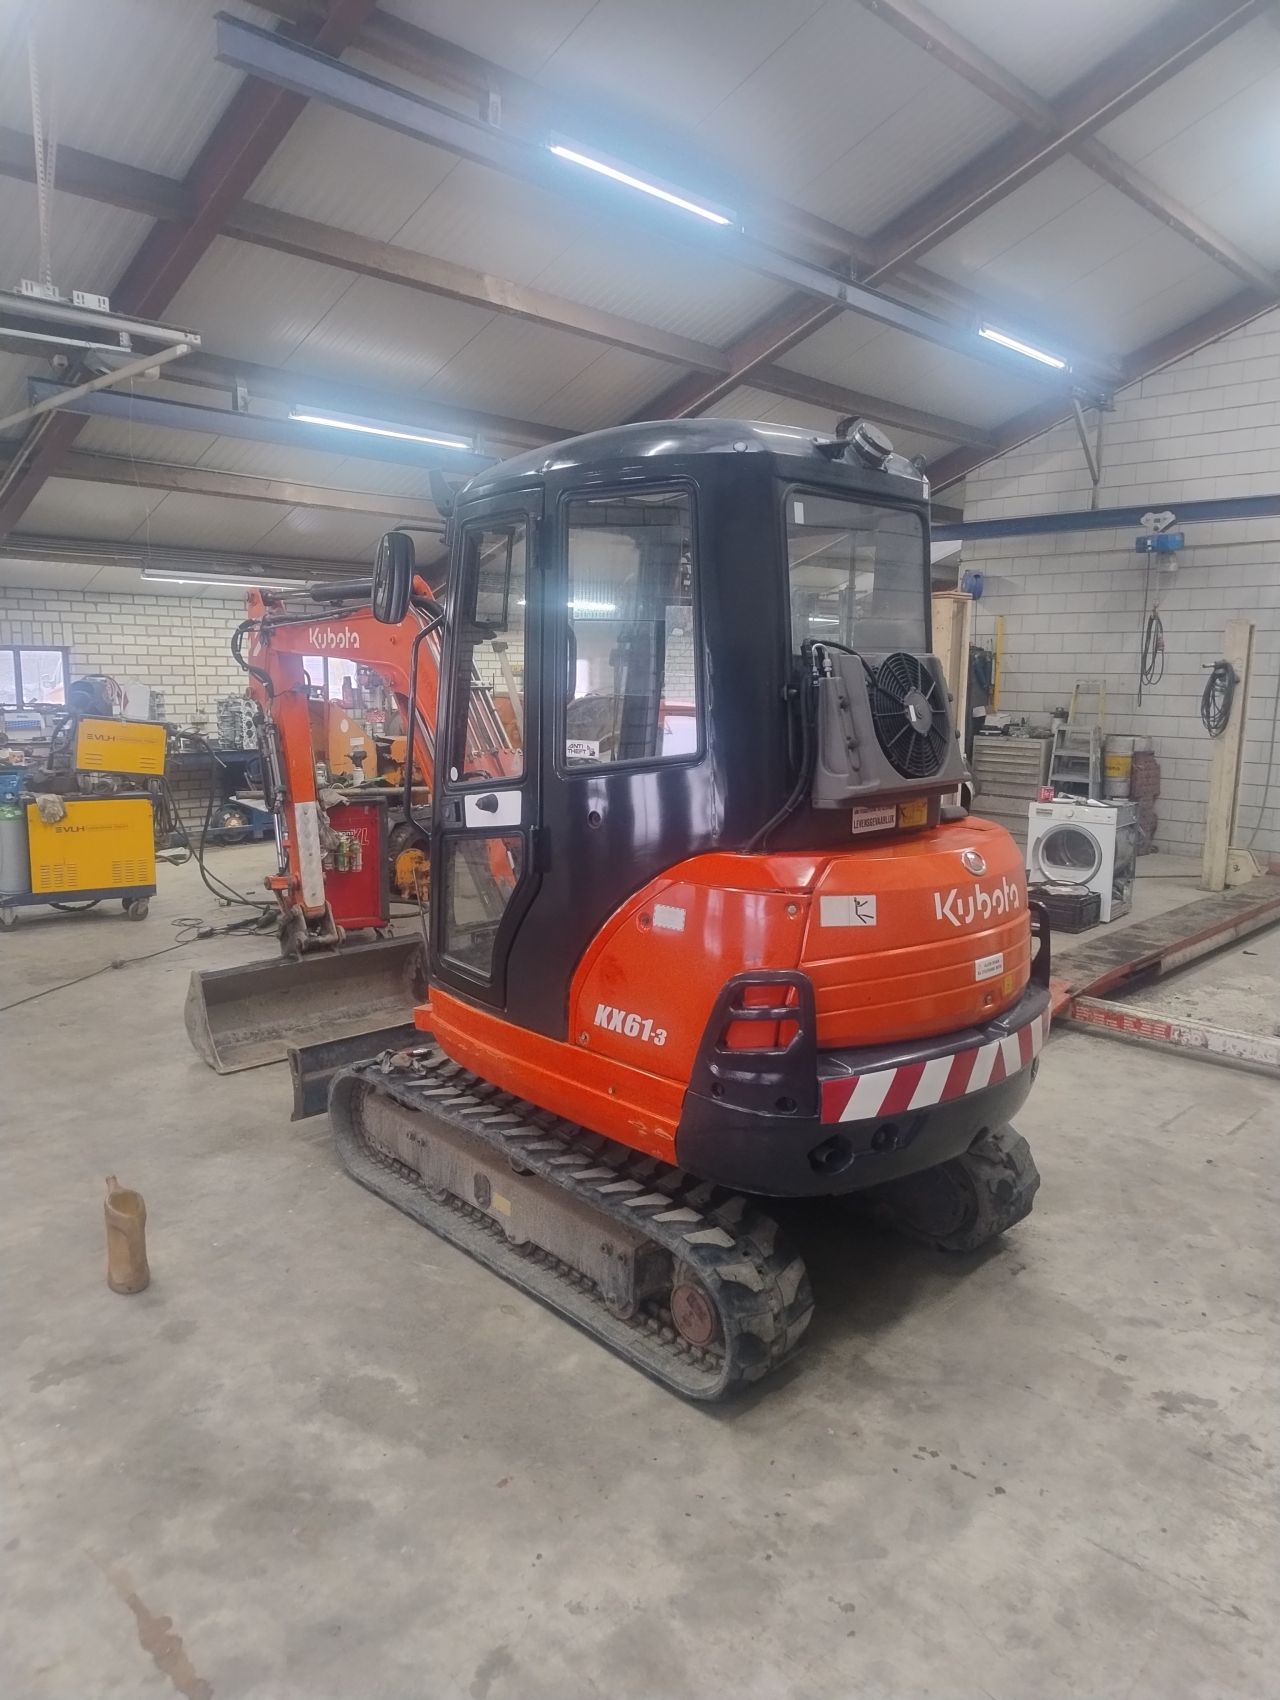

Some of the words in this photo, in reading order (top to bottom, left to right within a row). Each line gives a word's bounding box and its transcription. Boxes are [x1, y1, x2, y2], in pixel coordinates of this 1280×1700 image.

[309, 626, 360, 649] Kubota
[934, 876, 1020, 927] Kubota
[593, 1003, 668, 1046] KX61-3
